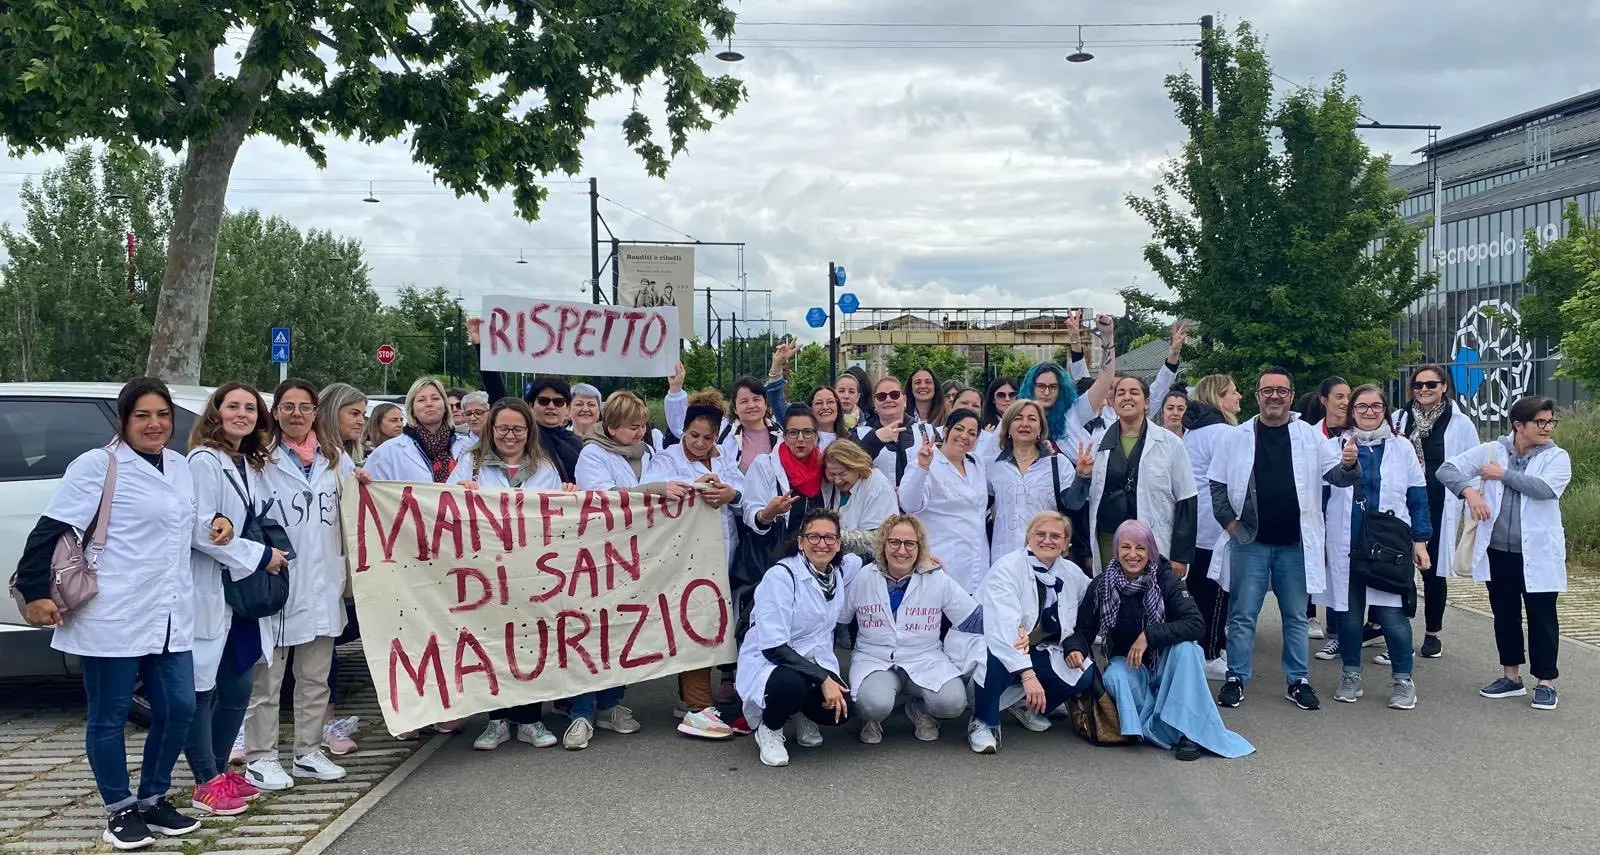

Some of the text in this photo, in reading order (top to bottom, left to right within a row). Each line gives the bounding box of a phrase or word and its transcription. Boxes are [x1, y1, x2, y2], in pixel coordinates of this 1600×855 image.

[378, 350, 394, 358] STOP
[489, 302, 667, 359] RISPETTO
[530, 534, 641, 602] SAN
[389, 577, 729, 713] MAURIZIO
[904, 623, 921, 631] SAN
